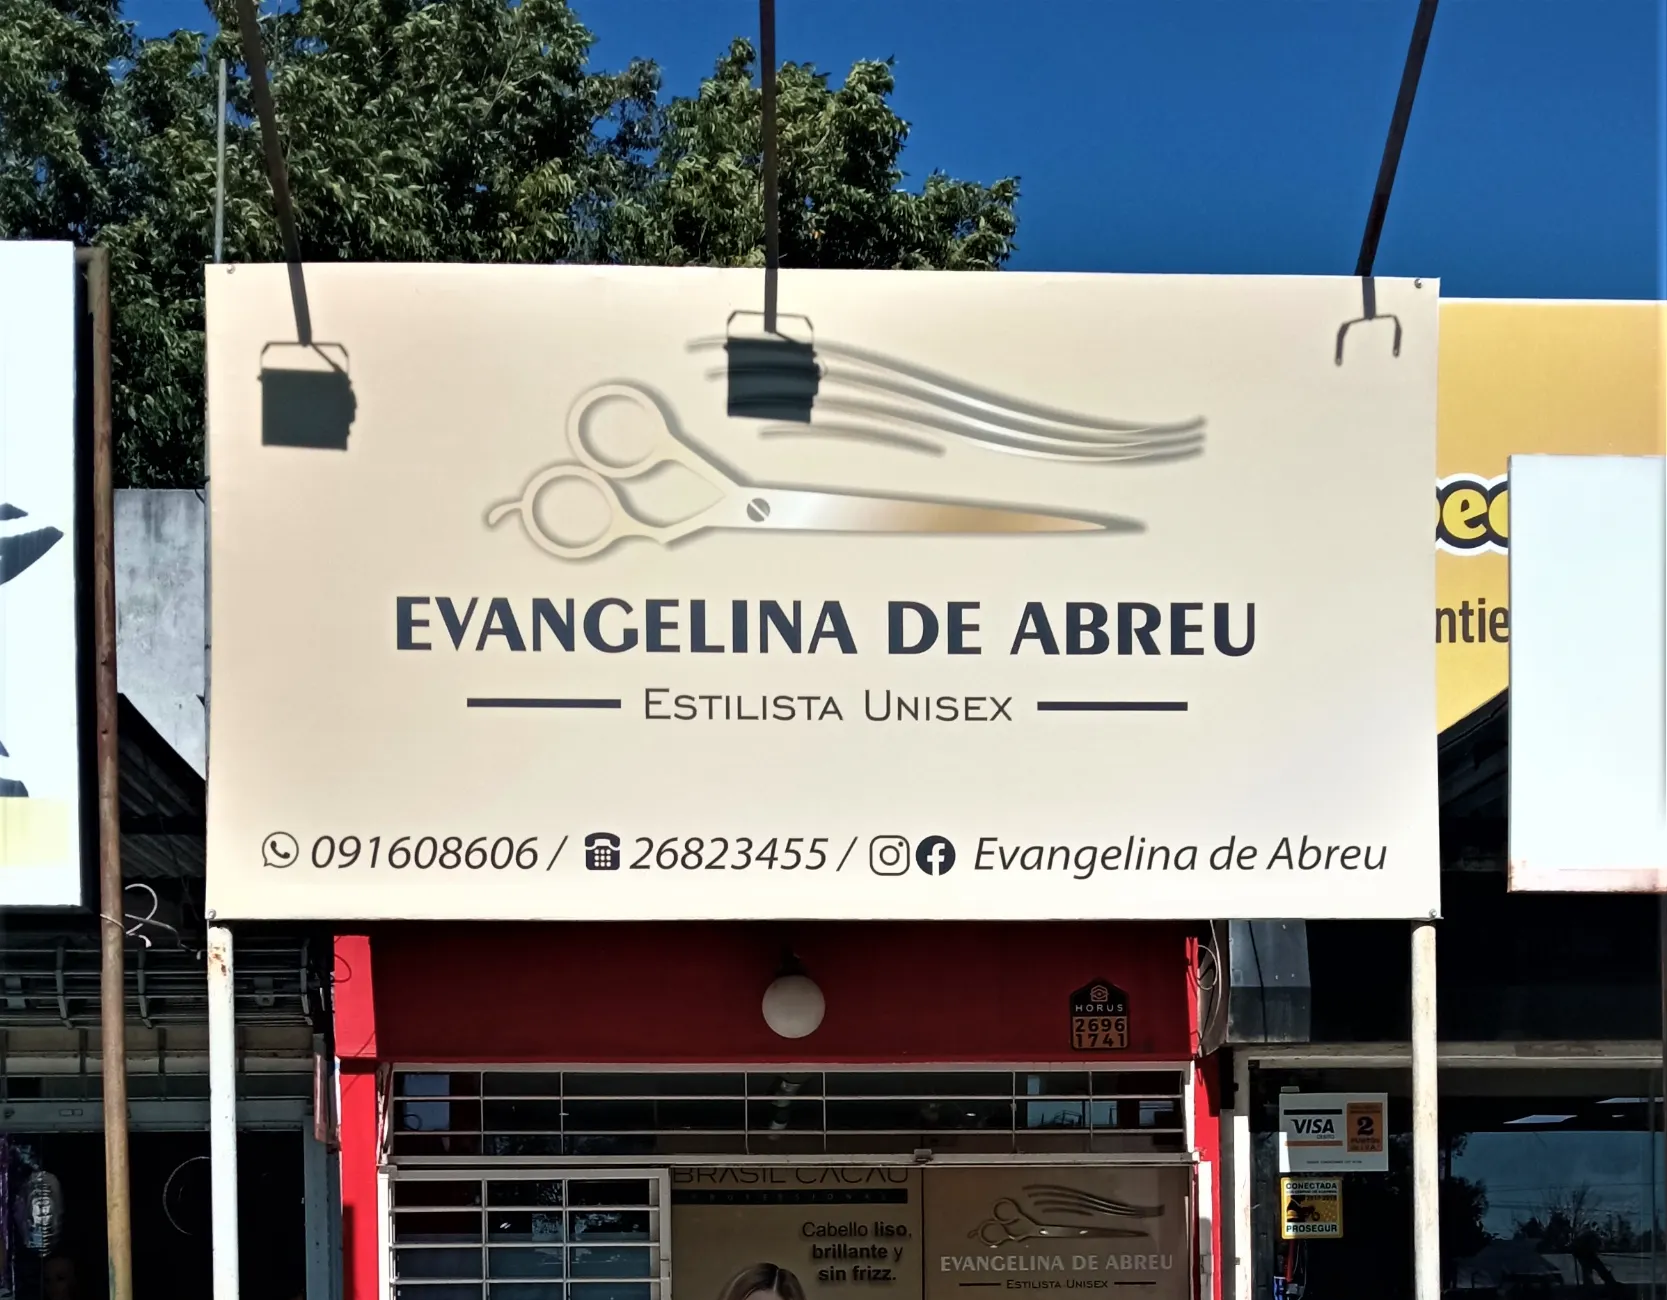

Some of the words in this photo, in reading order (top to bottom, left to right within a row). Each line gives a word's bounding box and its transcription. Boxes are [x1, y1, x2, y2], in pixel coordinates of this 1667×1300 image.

[396, 596, 858, 655] EVANGELINA
[888, 600, 982, 655] DE
[1010, 601, 1256, 657] ABREU
[311, 834, 539, 870] 091608606
[629, 836, 828, 871] 26823455
[974, 835, 1198, 881] Evangelina
[1209, 835, 1259, 872] de
[1266, 836, 1387, 871] Abreu
[1075, 1004, 1123, 1012] HORUS
[1075, 1018, 1125, 1033] 2696
[1075, 1033, 1125, 1047] 1741
[1290, 1119, 1335, 1134] VISA
[1357, 1116, 1374, 1136] 2
[673, 1168, 787, 1184] BRASIL
[795, 1168, 908, 1184] CACAU
[1285, 1182, 1338, 1190] CONECTADA
[802, 1221, 868, 1238] Cabello
[874, 1221, 912, 1240] liso,
[1286, 1224, 1338, 1233] PROSEGUR
[812, 1243, 888, 1260] brillante
[894, 1246, 904, 1262] y
[940, 1255, 1064, 1272] EVANGELINA
[1072, 1254, 1098, 1270] DE
[1105, 1253, 1173, 1270] ABREU
[818, 1265, 846, 1281] sin
[853, 1265, 896, 1281] frizz.
